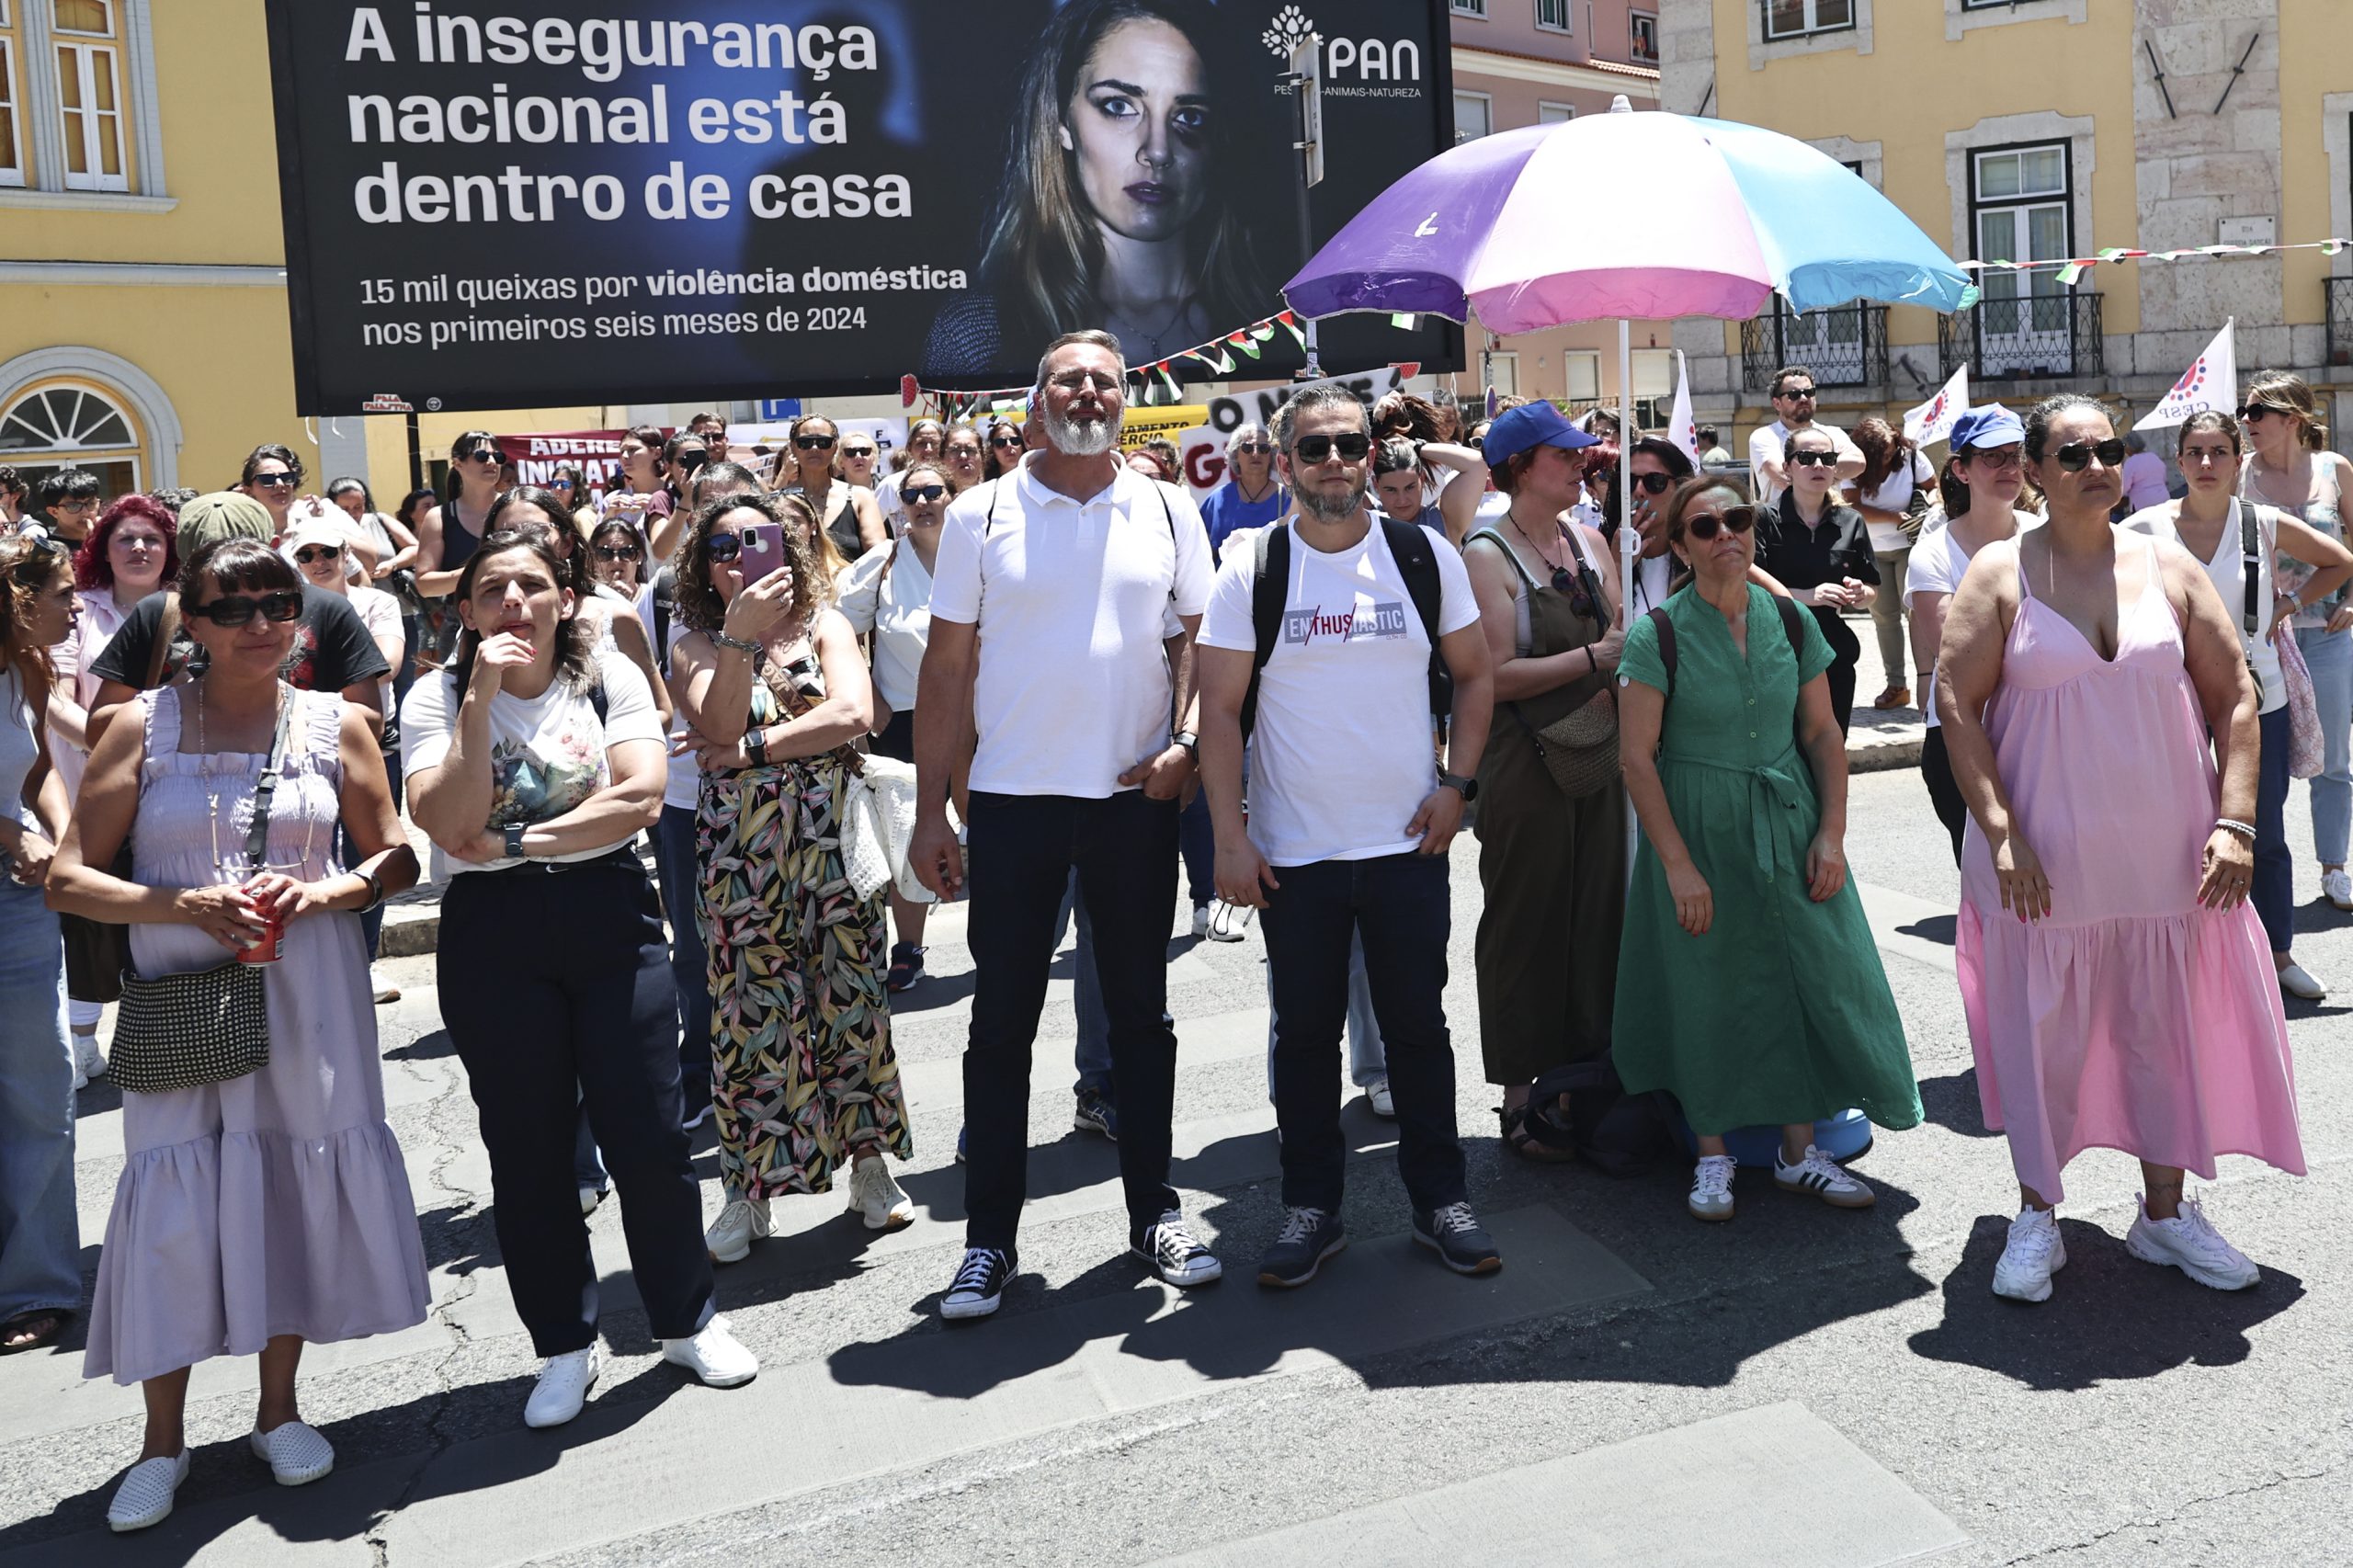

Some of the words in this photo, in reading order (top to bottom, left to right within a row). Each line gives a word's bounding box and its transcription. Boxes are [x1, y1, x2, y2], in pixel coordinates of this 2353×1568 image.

[346, 7, 396, 62] A
[415, 2, 877, 82] insegurança
[1328, 37, 1420, 80] PAN
[348, 83, 669, 143] nacional
[688, 90, 847, 143] está
[354, 162, 625, 223] dentro
[644, 161, 731, 220] de
[748, 174, 912, 218] casa
[360, 278, 395, 304] 15
[404, 274, 448, 302] mil
[457, 274, 576, 309] queixas
[585, 277, 638, 308] por
[646, 267, 795, 296] violência
[802, 265, 967, 291] doméstica
[363, 322, 422, 346] nos
[430, 314, 586, 350] primeiros
[595, 312, 656, 337] seis
[663, 312, 759, 335] meses
[766, 305, 800, 332] de
[806, 306, 867, 331] 2024
